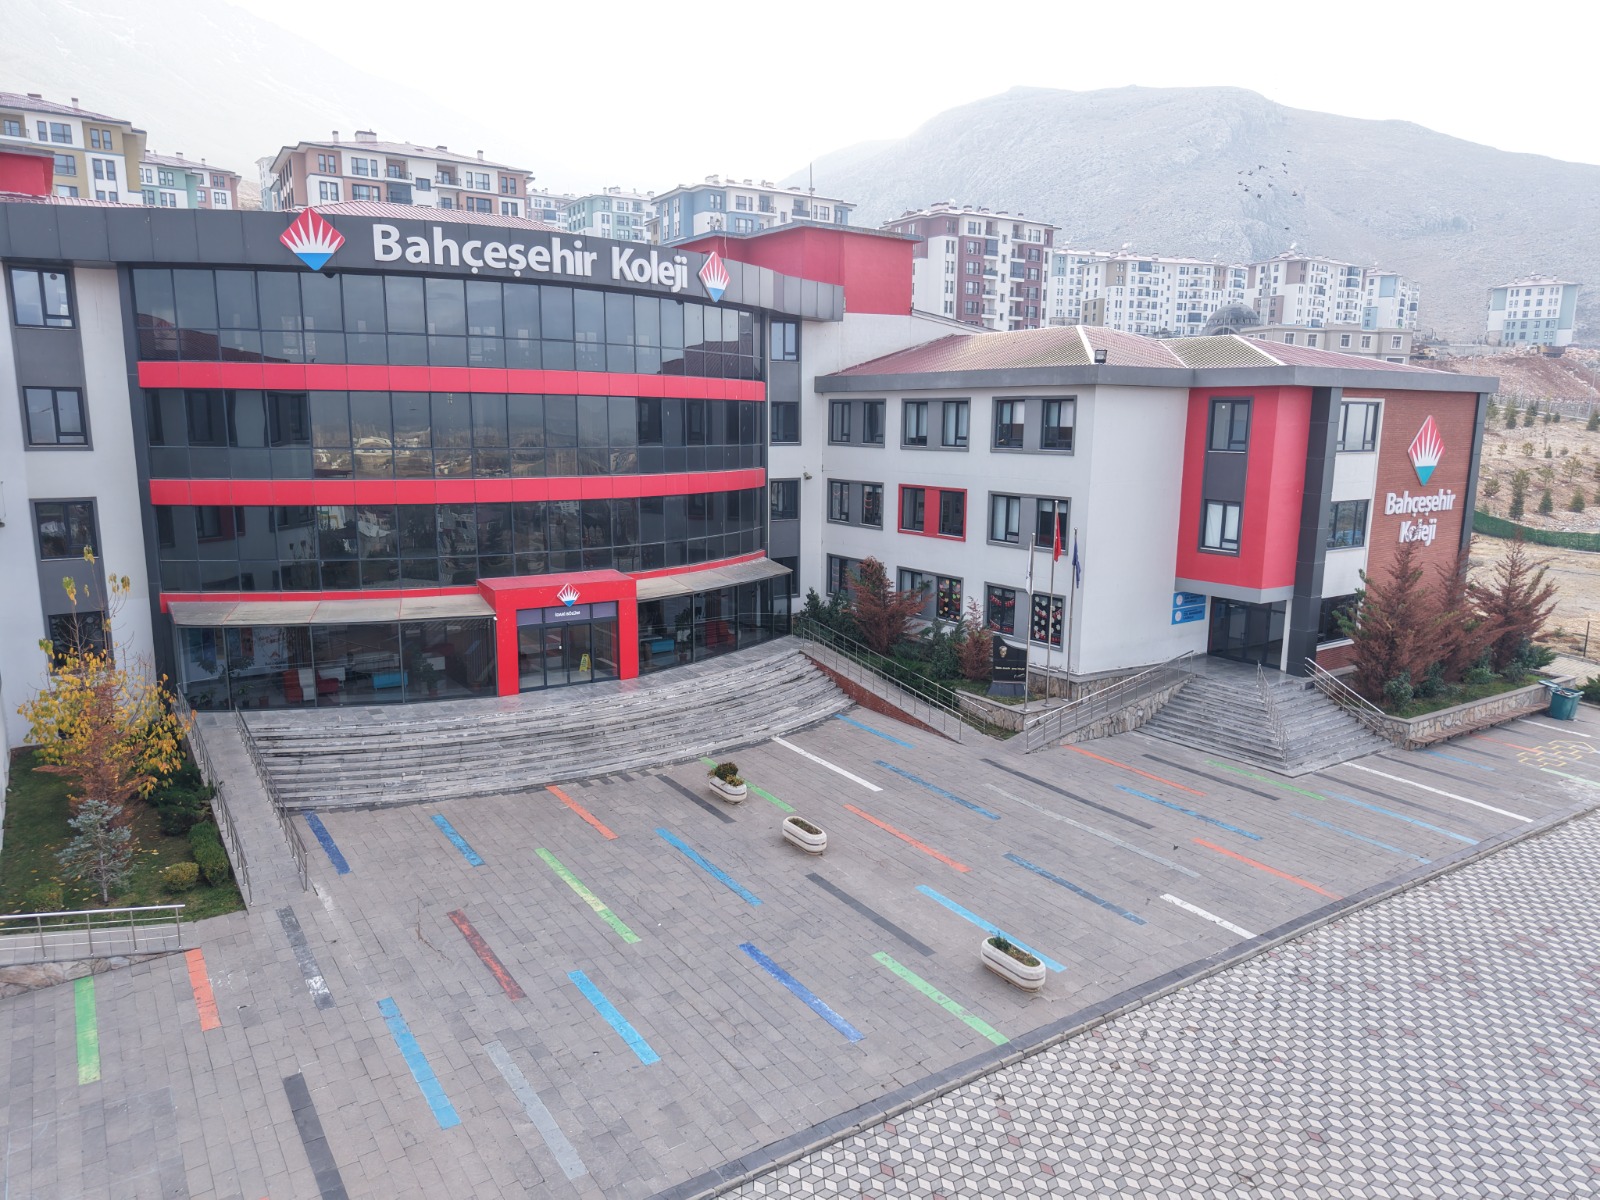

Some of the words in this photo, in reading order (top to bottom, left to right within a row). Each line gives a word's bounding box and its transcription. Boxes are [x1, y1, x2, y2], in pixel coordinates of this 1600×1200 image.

[372, 223, 598, 278] Bahçeşehir
[611, 246, 688, 293] Koleji
[1384, 488, 1456, 517] Bahçeşehir
[1398, 518, 1438, 546] Koleji
